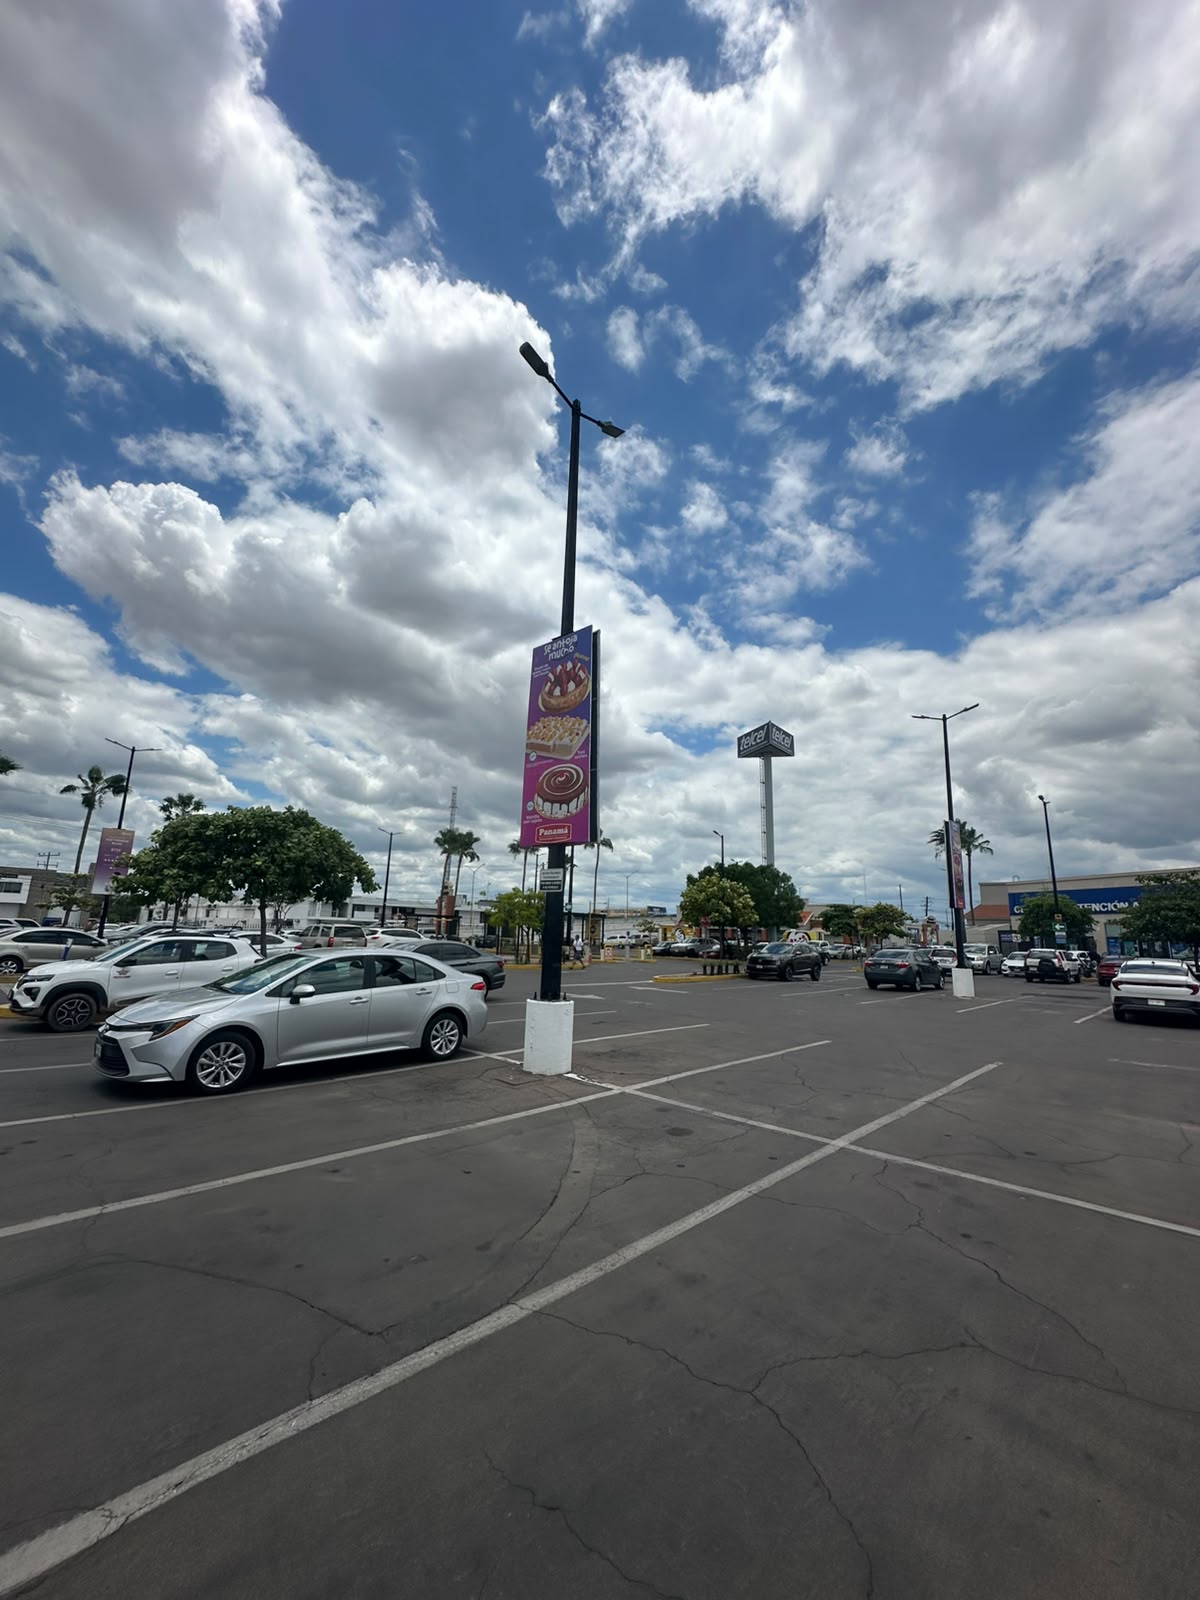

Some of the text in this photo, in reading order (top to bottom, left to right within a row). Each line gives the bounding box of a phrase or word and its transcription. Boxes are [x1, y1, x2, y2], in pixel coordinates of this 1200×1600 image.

[552, 634, 577, 650] antoja
[548, 645, 575, 661] mucho
[740, 724, 768, 751] telcel
[772, 727, 793, 748] telcel
[539, 825, 568, 836] Panamá
[1076, 900, 1128, 912] TENCIÓN
